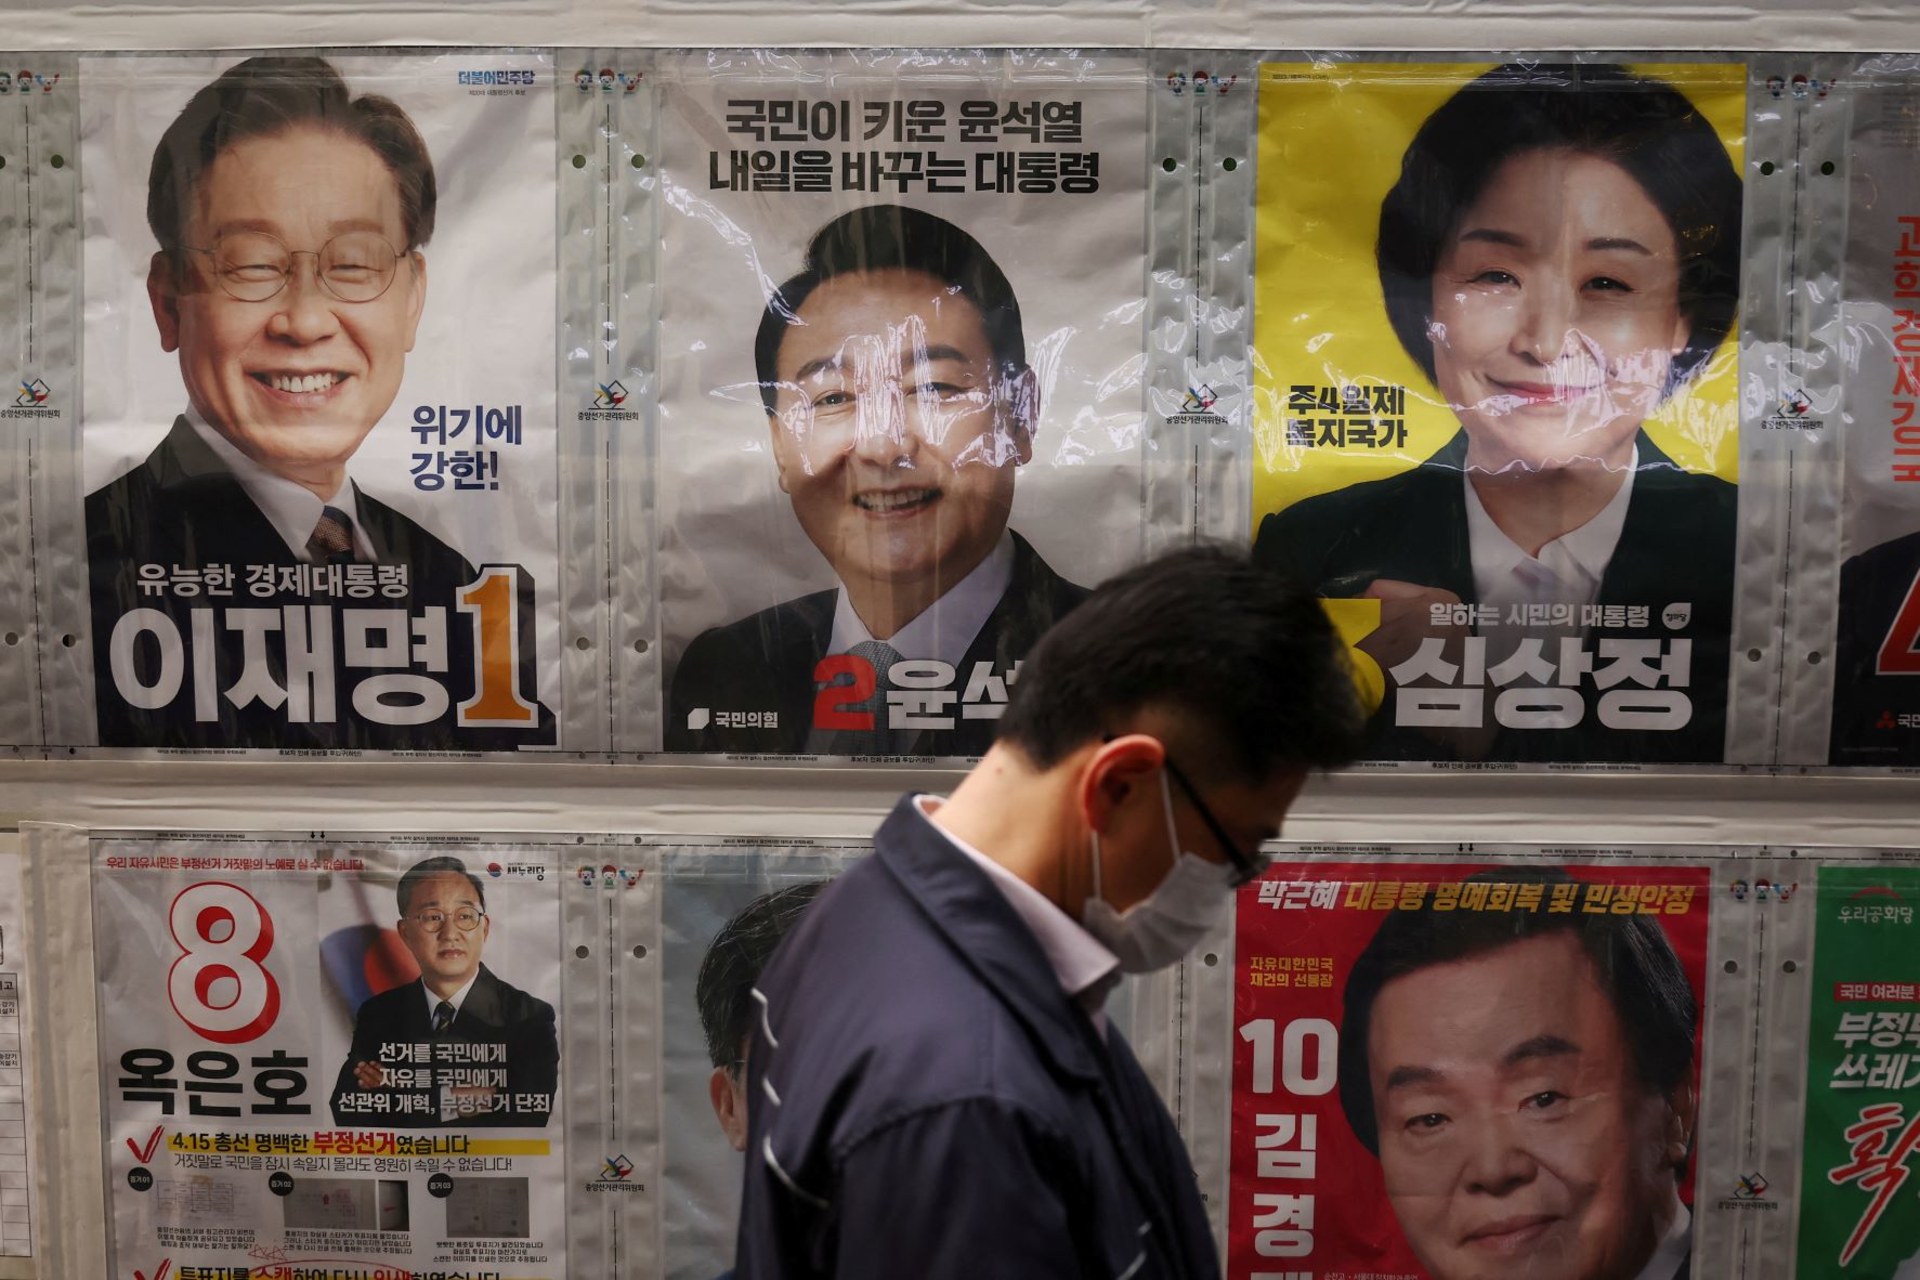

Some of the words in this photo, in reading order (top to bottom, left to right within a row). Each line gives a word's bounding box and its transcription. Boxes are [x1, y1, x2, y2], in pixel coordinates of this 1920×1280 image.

[459, 70, 535, 85] 더불어민주당
[727, 101, 849, 142] 국민이
[863, 101, 945, 143] 키운
[958, 101, 1082, 143] 윤석열
[709, 151, 833, 193] 내일을
[842, 151, 965, 193] 바꾸는
[975, 152, 1100, 194] 대통령
[1288, 385, 1405, 415] 주4일제
[1, 409, 61, 418] 중앙선거관리위원회
[411, 405, 522, 445] 위기에
[578, 412, 639, 420] 중앙선거관리위원회
[1286, 419, 1408, 448] 복지국가
[410, 452, 499, 491] 강한!
[137, 564, 234, 596] 유능한
[245, 565, 409, 598] 경제대통령
[1429, 602, 1499, 626] 일하는
[1505, 603, 1574, 627] 시민의
[1581, 604, 1650, 628] 대통령
[456, 564, 540, 728] 1
[110, 605, 449, 725] 이재명
[813, 654, 877, 731] 2
[1389, 636, 1694, 731] 심상정
[715, 710, 779, 729] 국민의힘
[107, 857, 127, 869] 우리
[129, 857, 179, 869] 자유시민은
[181, 858, 221, 870] 부정선거
[223, 858, 263, 870] 거짓말의
[265, 858, 296, 870] 노예로
[310, 859, 321, 870] 수
[323, 859, 364, 871] 없습니다
[507, 866, 545, 881] 새누리당
[1258, 880, 1341, 910] 박근혜
[1344, 881, 1425, 911] 대통령
[1432, 883, 1544, 913] 명예회복
[1547, 884, 1577, 912] 및
[1581, 885, 1696, 915] 민생안정
[1838, 906, 1914, 924] 우리공화당
[168, 881, 280, 1044] 8
[1250, 956, 1334, 972] 자유대한민국
[0, 981, 14, 991] 고
[1250, 972, 1290, 988] 재건의
[1293, 973, 1334, 988] 선봉장
[1840, 984, 1868, 998] 국민
[1871, 984, 1916, 999] 여러분
[379, 1043, 432, 1063] 선거를
[436, 1043, 507, 1063] 국민에게
[1239, 1018, 1339, 1096] 10
[118, 1047, 312, 1118] 옥은호
[379, 1068, 433, 1088] 자유를
[436, 1068, 508, 1088] 국민에게
[339, 1093, 391, 1113] 선관위
[395, 1094, 436, 1115] 개혁,
[440, 1093, 510, 1113] 부정선거
[514, 1093, 550, 1113] 단죄
[173, 1132, 211, 1151] 4.15
[214, 1132, 250, 1153] 총선
[254, 1132, 309, 1154] 명백한
[313, 1131, 471, 1155] 부정선거였습니다
[174, 1153, 223, 1170] 거짓말로
[225, 1154, 264, 1170] 국민을
[266, 1155, 290, 1171] 잠시
[293, 1156, 331, 1172] 속일지
[333, 1157, 371, 1172] 몰라도
[374, 1157, 412, 1173] 영원히
[414, 1158, 440, 1172] 속일
[443, 1158, 455, 1171] 수
[458, 1157, 513, 1172] 없습니다!
[142, 1175, 150, 1184] 01
[585, 1183, 645, 1192] 중앙선거관리위원회
[1250, 1113, 1318, 1280] 김경
